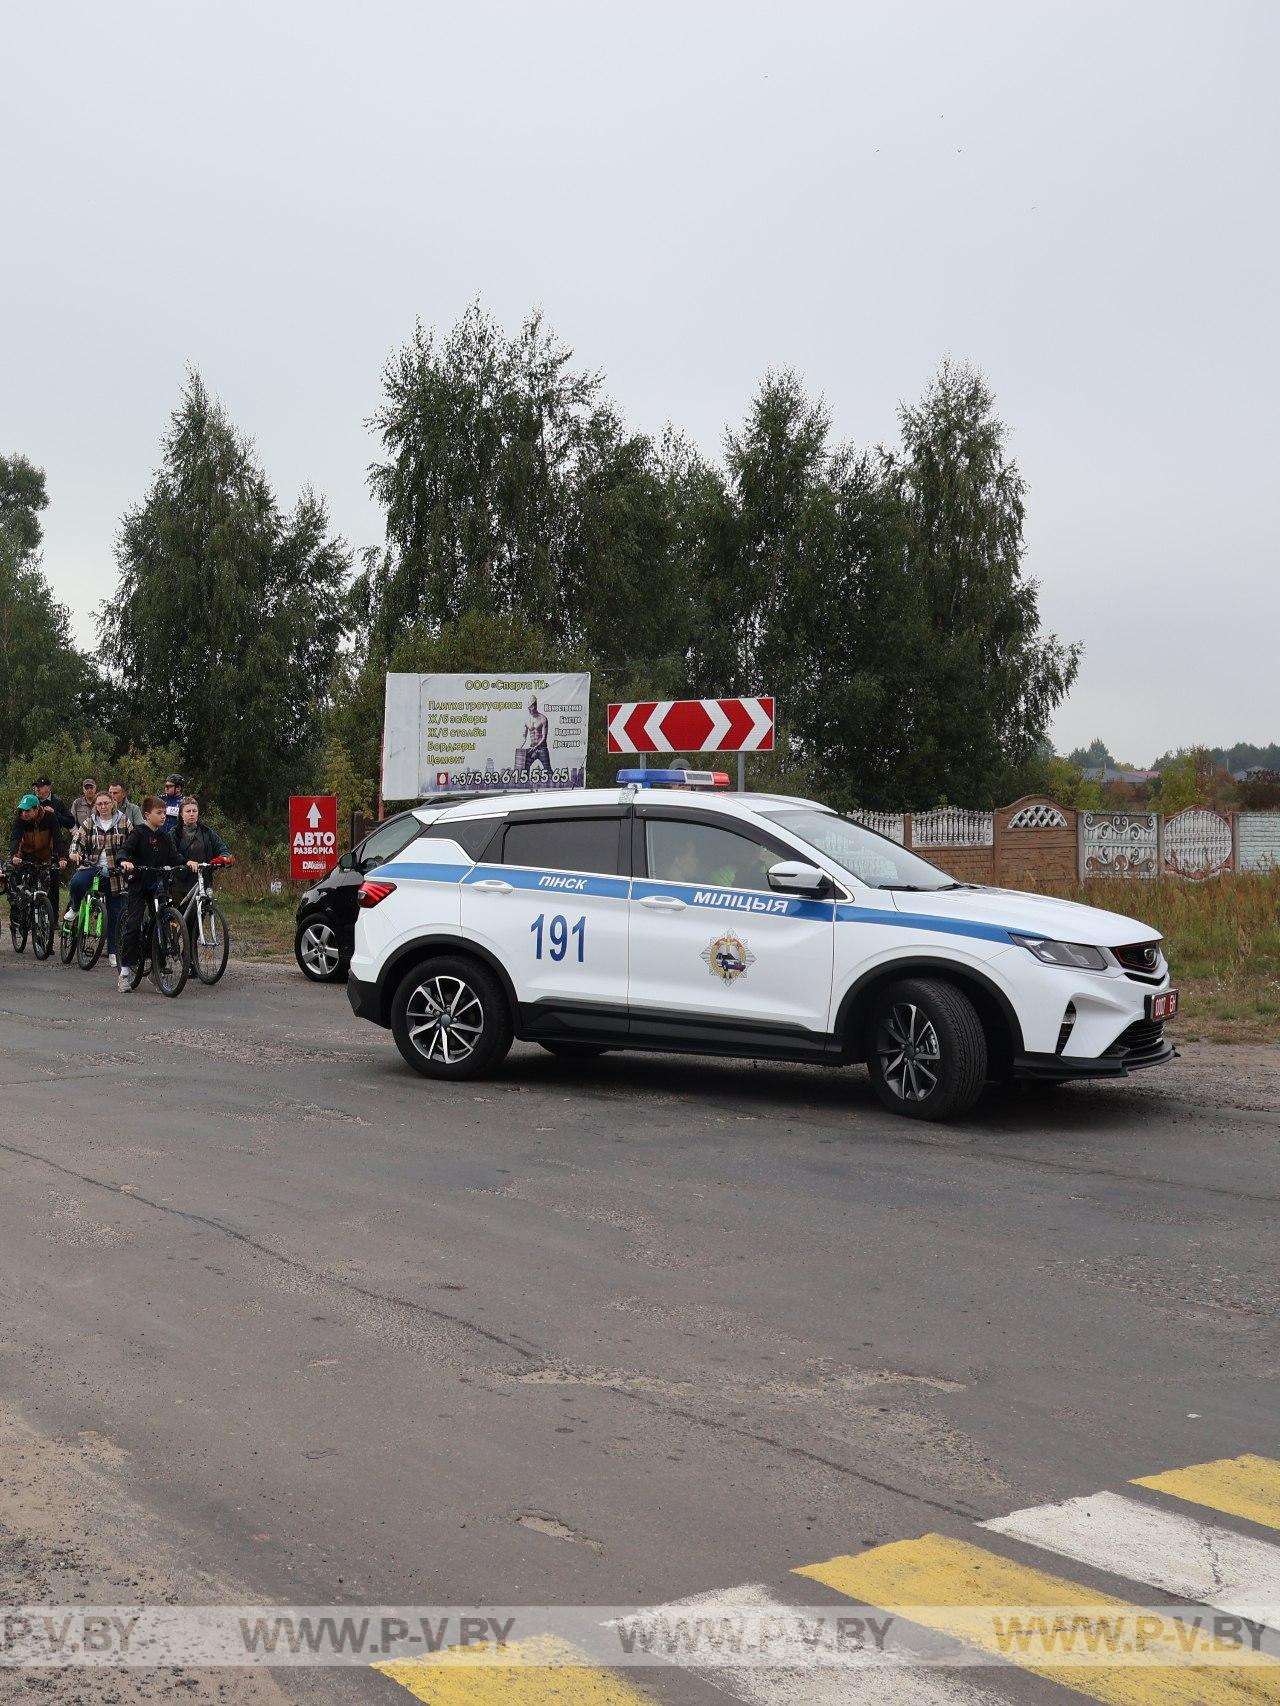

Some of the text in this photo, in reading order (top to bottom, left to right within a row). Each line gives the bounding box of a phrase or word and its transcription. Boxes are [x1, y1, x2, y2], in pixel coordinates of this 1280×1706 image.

[465, 680, 490, 690] ООО
[491, 680, 532, 691] «Спарта
[428, 701, 523, 711] Плитка тротуарная
[450, 714, 488, 725] заборы
[450, 727, 487, 737] столбы
[427, 741, 476, 752] Бордюры
[452, 772, 482, 785] +375
[484, 772, 500, 784] 33
[530, 768, 549, 783] 55
[551, 767, 570, 781] 65
[293, 832, 335, 846] АВТО
[294, 847, 334, 855] РАЗБОРКА
[538, 876, 587, 890] ПІНСК
[694, 891, 789, 914] МІЛІЦЫЯ
[530, 913, 586, 962] 191
